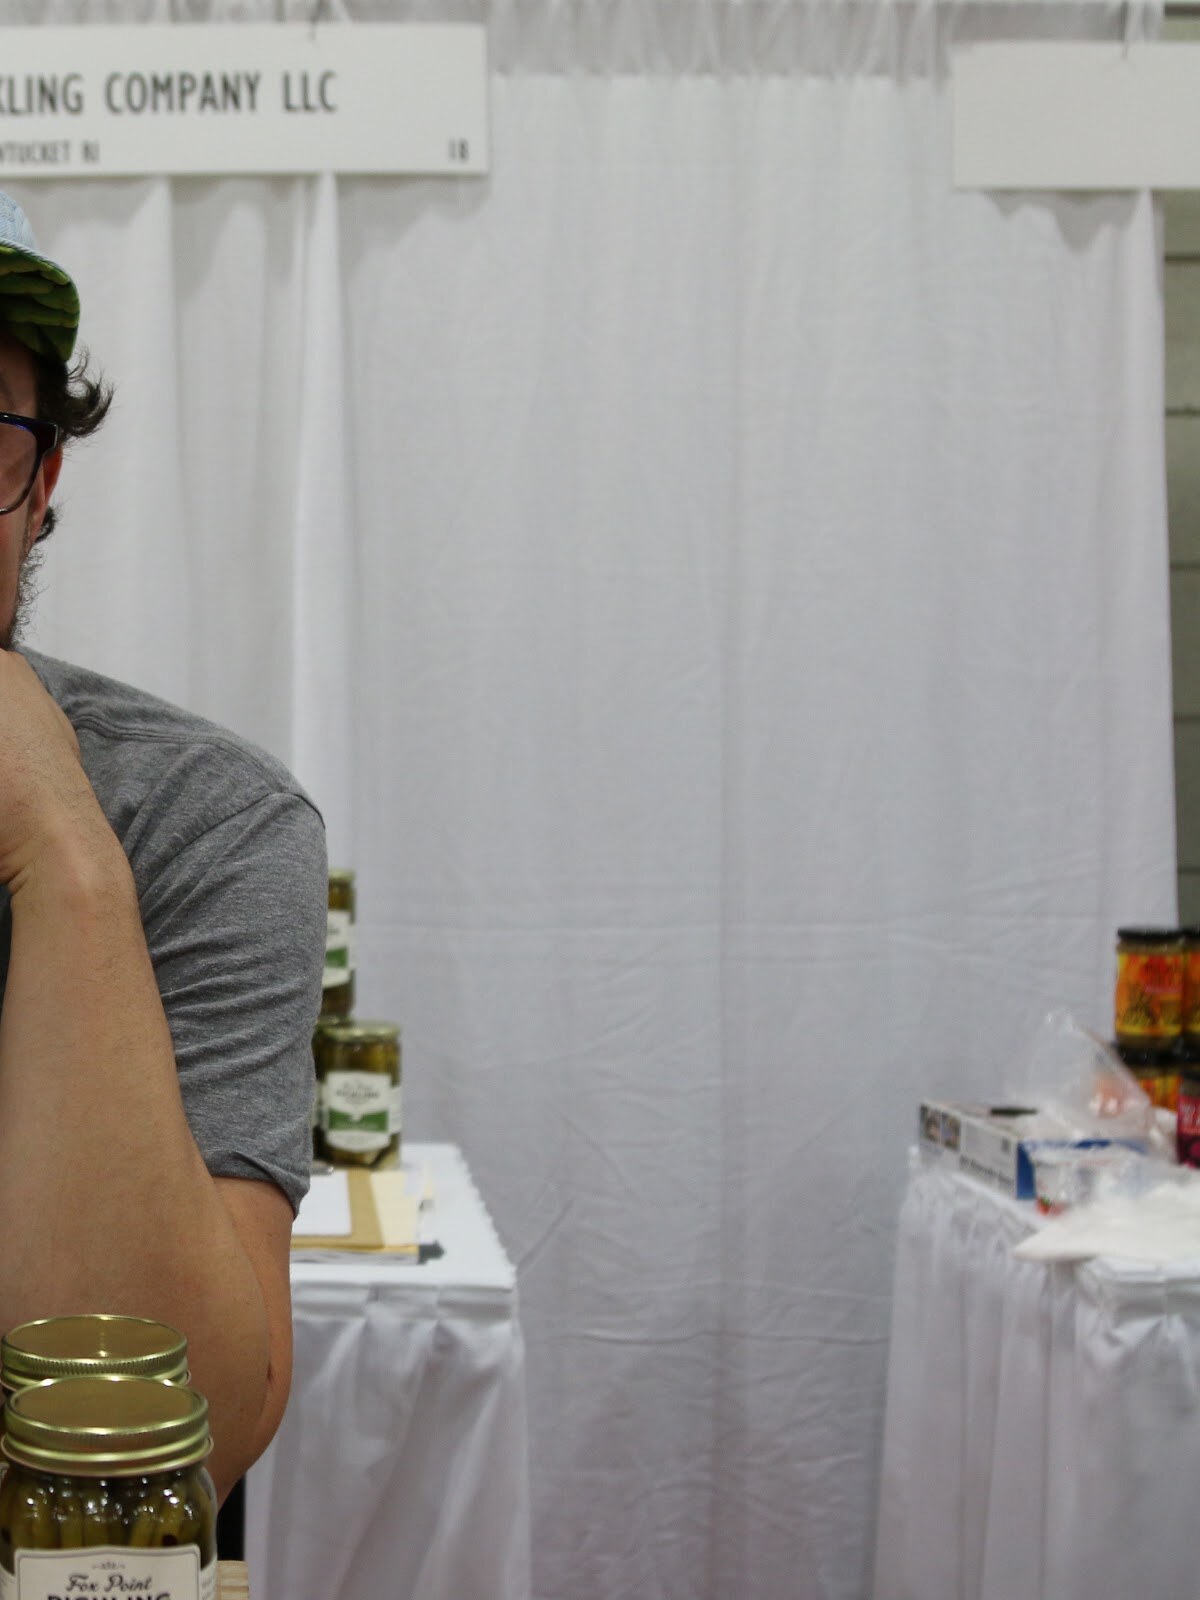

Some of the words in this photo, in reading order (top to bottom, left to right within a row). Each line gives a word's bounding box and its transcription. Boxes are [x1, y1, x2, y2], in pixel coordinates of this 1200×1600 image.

[105, 71, 261, 114] COMPANY
[282, 71, 338, 113] LLC
[81, 140, 100, 163] RI
[66, 1573, 98, 1592] Fox
[104, 1573, 152, 1592] Point
